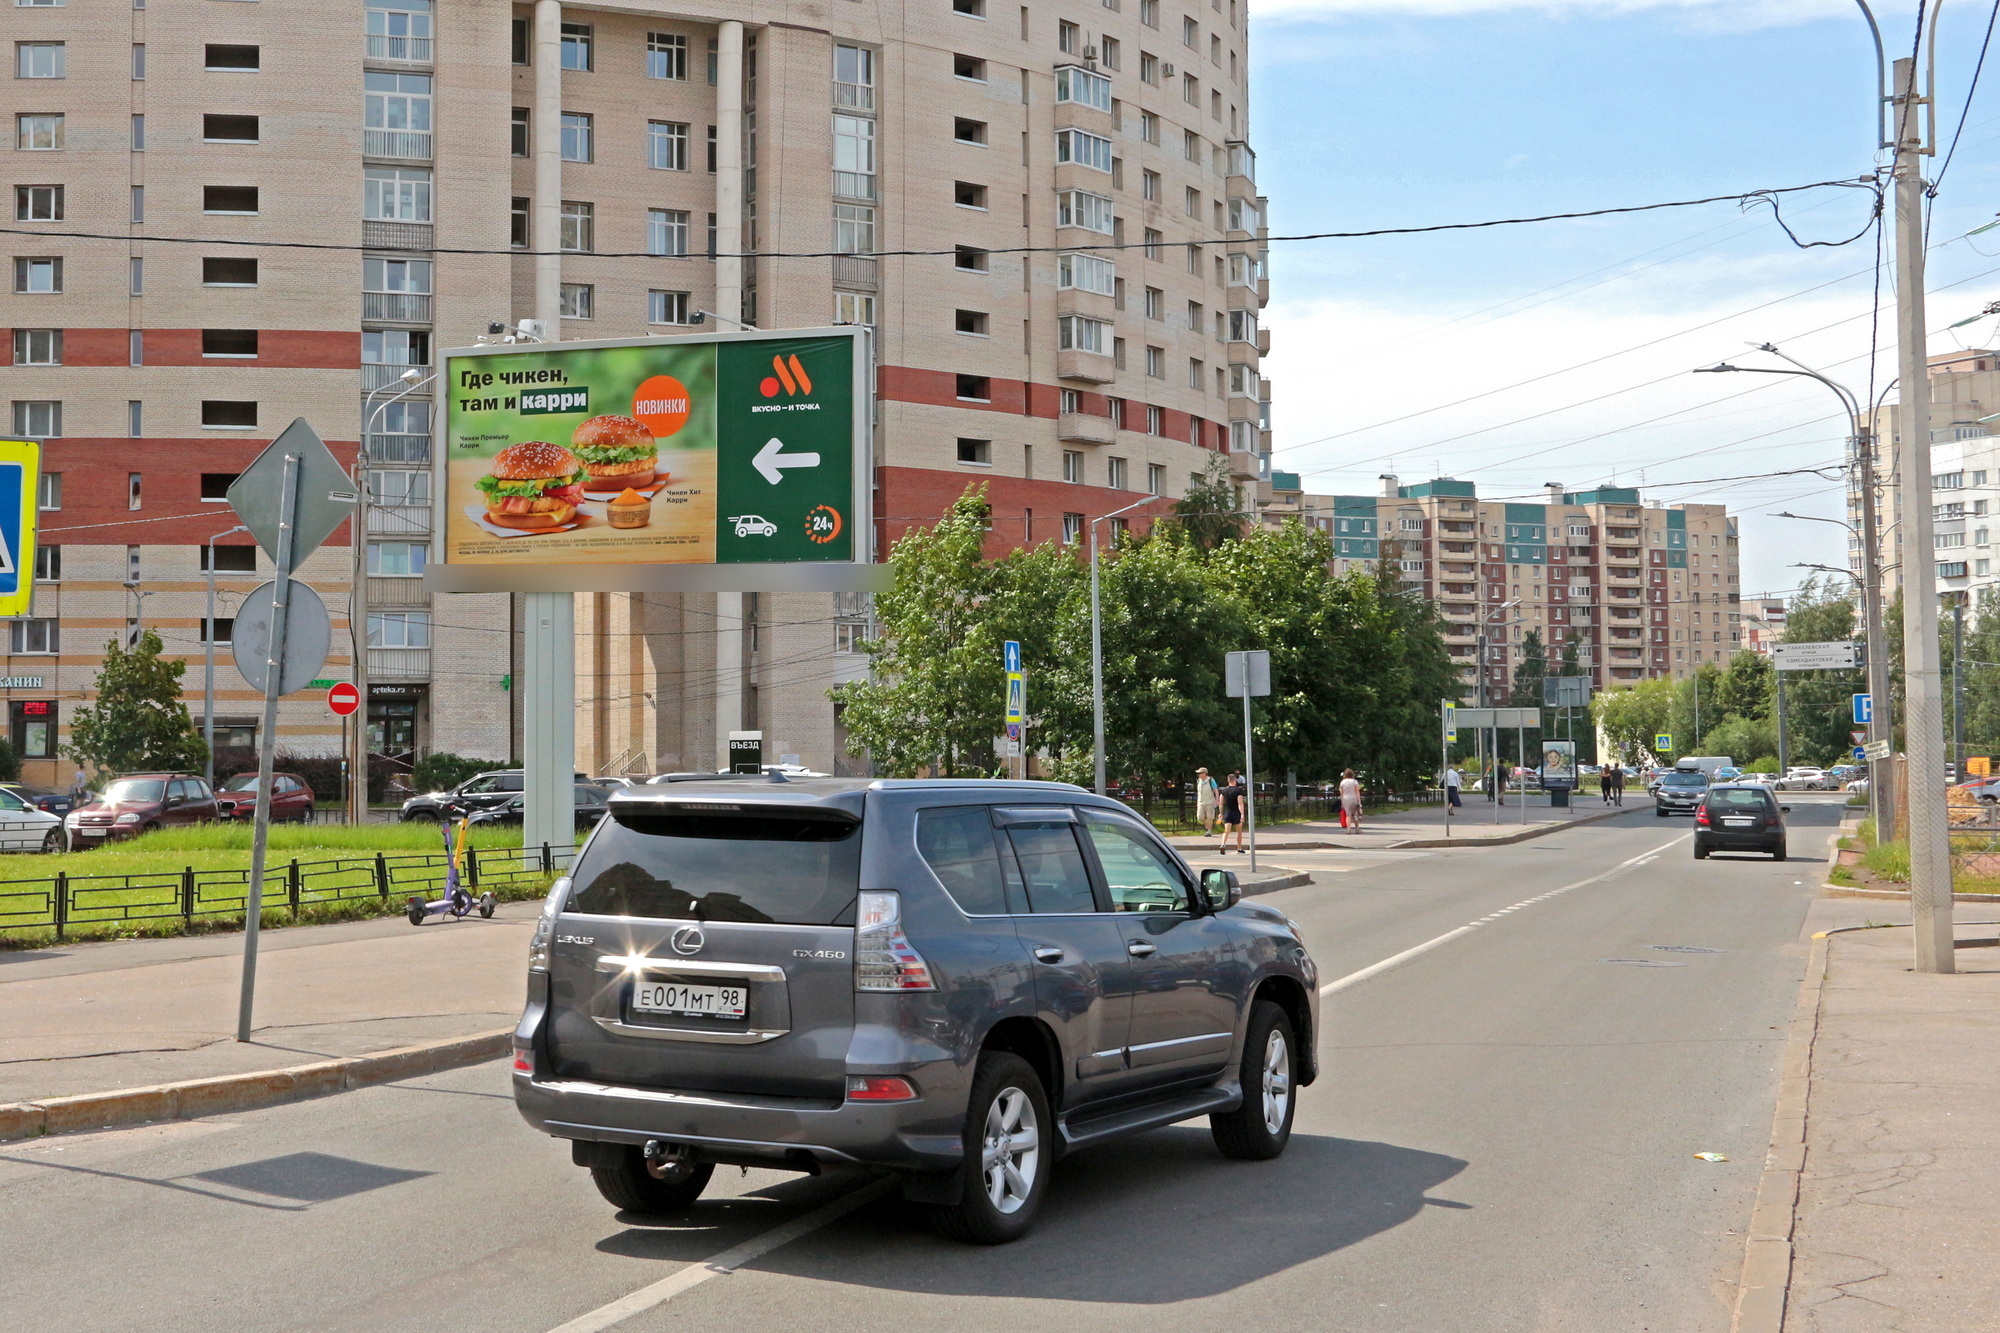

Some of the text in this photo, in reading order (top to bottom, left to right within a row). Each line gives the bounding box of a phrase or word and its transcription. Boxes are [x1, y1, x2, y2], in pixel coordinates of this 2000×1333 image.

[461, 369, 568, 389] Где чикен,
[460, 392, 587, 411] там и карри
[636, 398, 686, 415] НОВИНКИ
[751, 405, 781, 413] ВКУСНО
[795, 403, 820, 411] ТОЧКА
[459, 442, 479, 450] Карри
[730, 741, 760, 750] ВЪЕЗД
[557, 934, 594, 945] LEXUS
[721, 989, 739, 1006] 98
